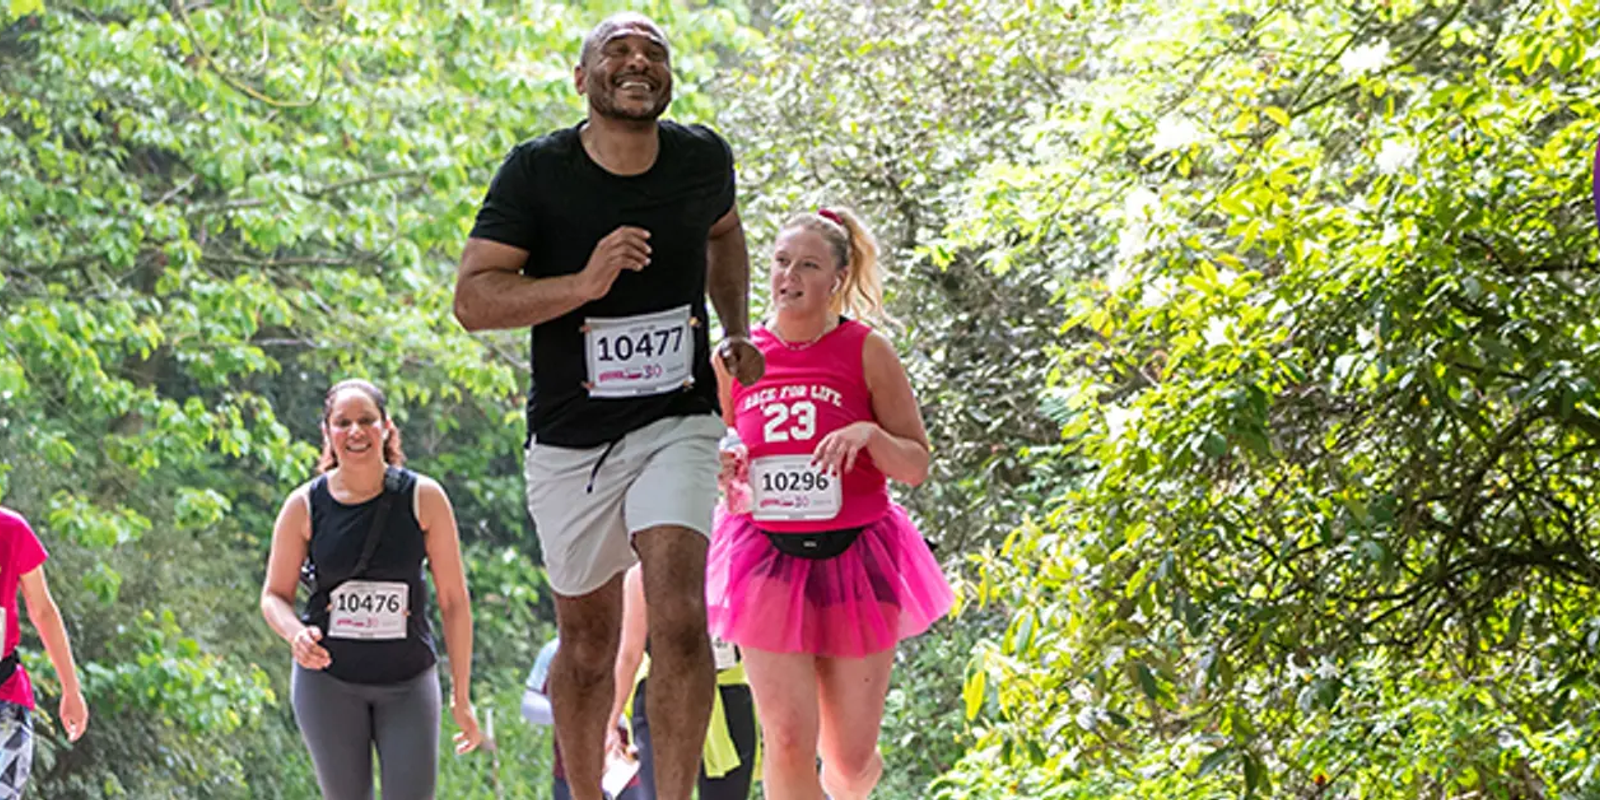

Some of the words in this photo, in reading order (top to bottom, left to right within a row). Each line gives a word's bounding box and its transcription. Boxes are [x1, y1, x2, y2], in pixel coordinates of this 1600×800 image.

[598, 326, 683, 361] 10477
[811, 385, 842, 407] LIFE
[764, 401, 816, 443] 23
[763, 472, 829, 491] 10296
[337, 593, 400, 613] 10476
